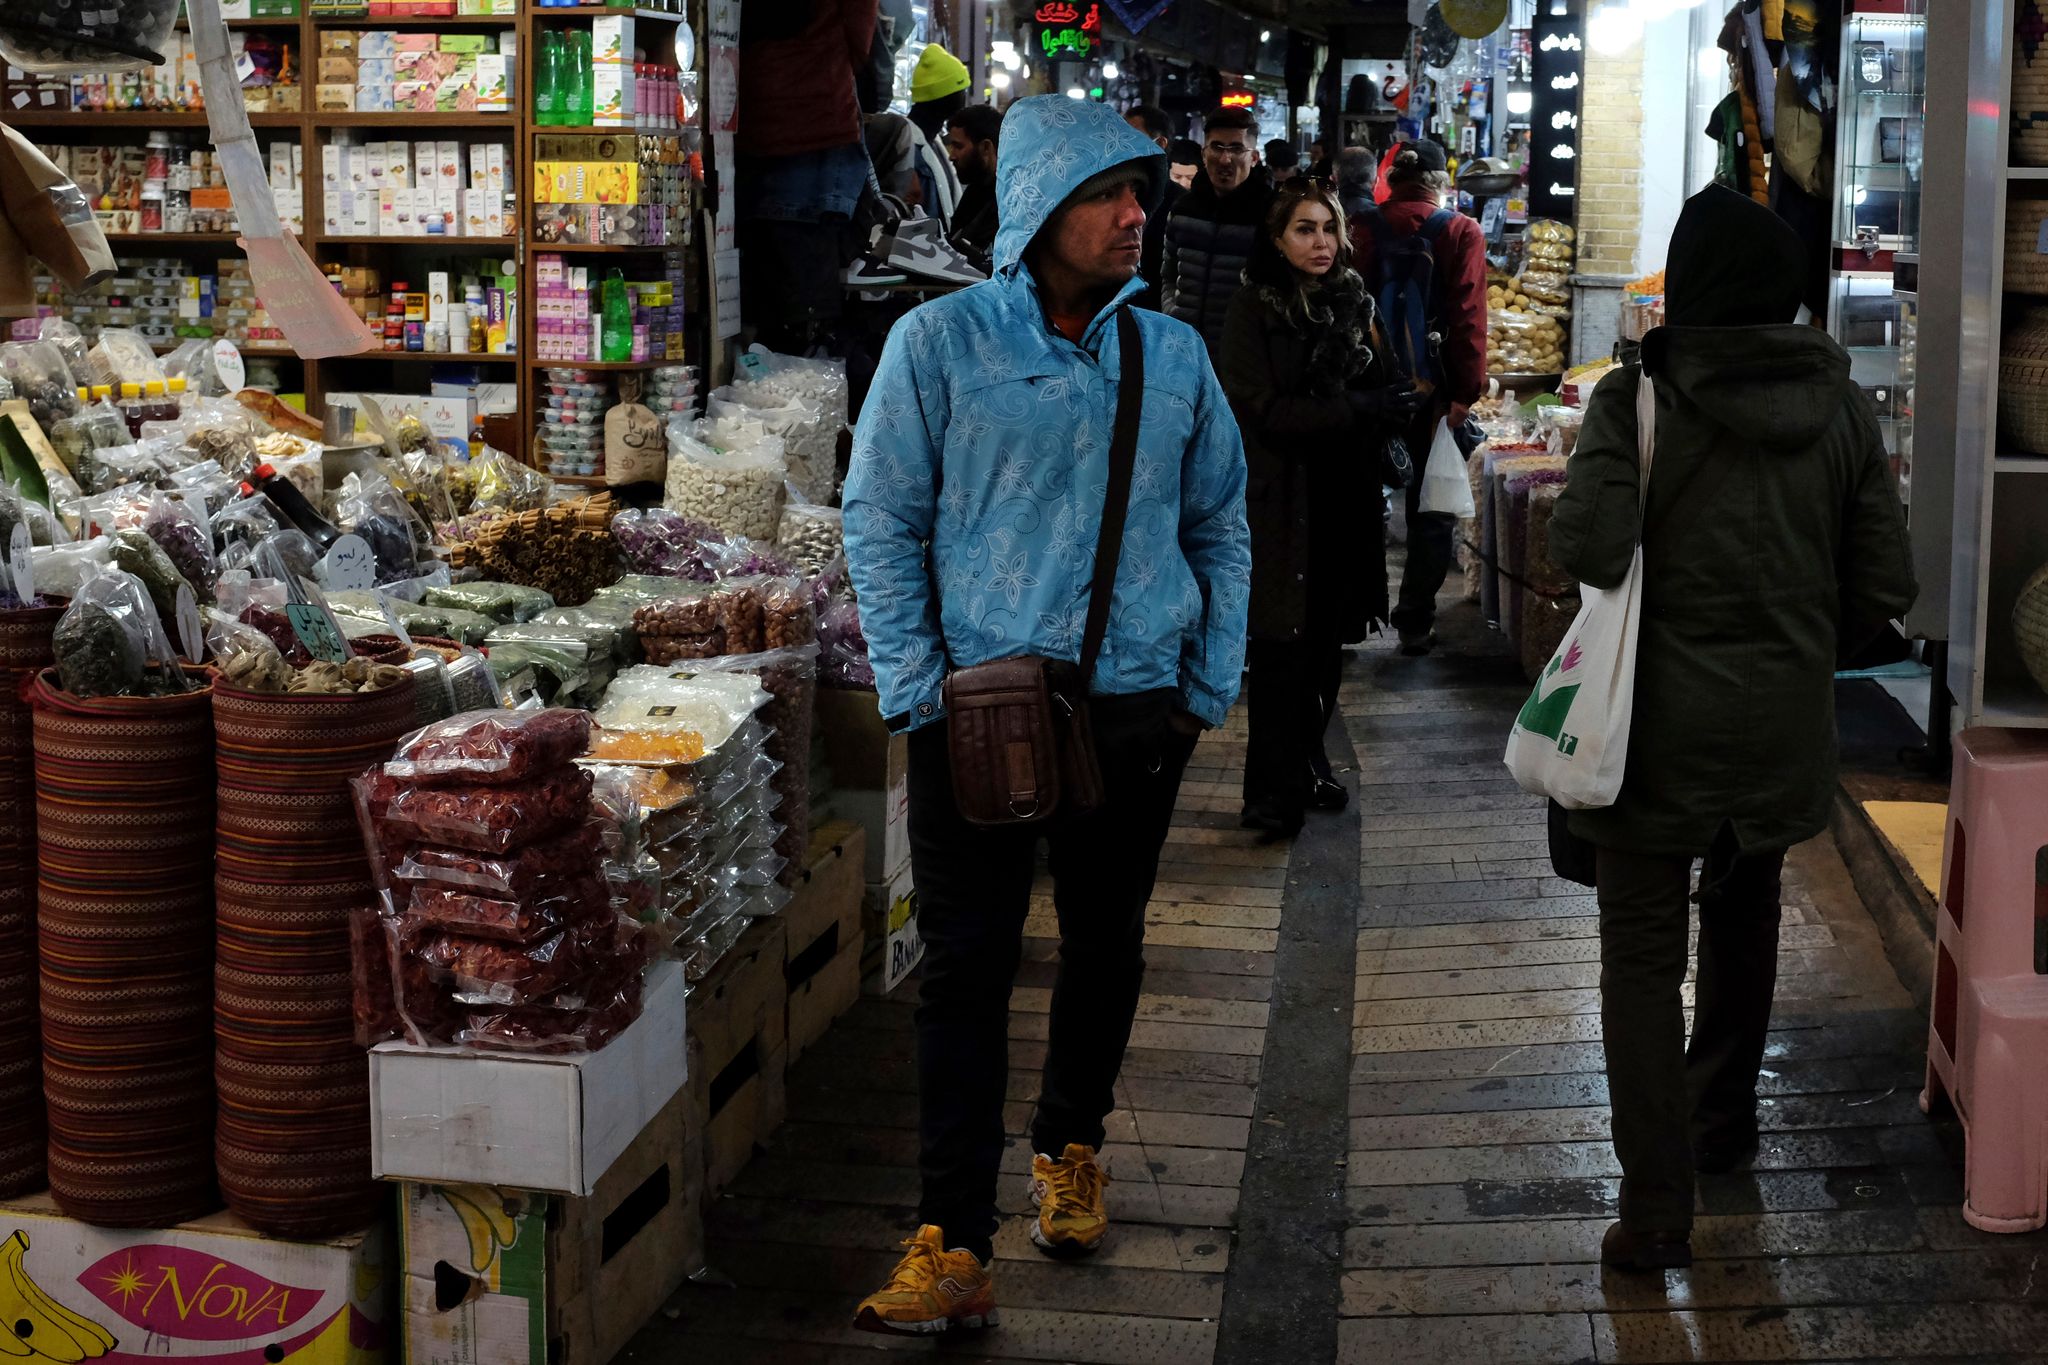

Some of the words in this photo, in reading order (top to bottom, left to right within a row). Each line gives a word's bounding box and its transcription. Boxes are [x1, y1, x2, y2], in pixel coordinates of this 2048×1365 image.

[574, 165, 585, 200] Mango
[494, 292, 502, 324] moov
[142, 1263, 288, 1326] NOVA
